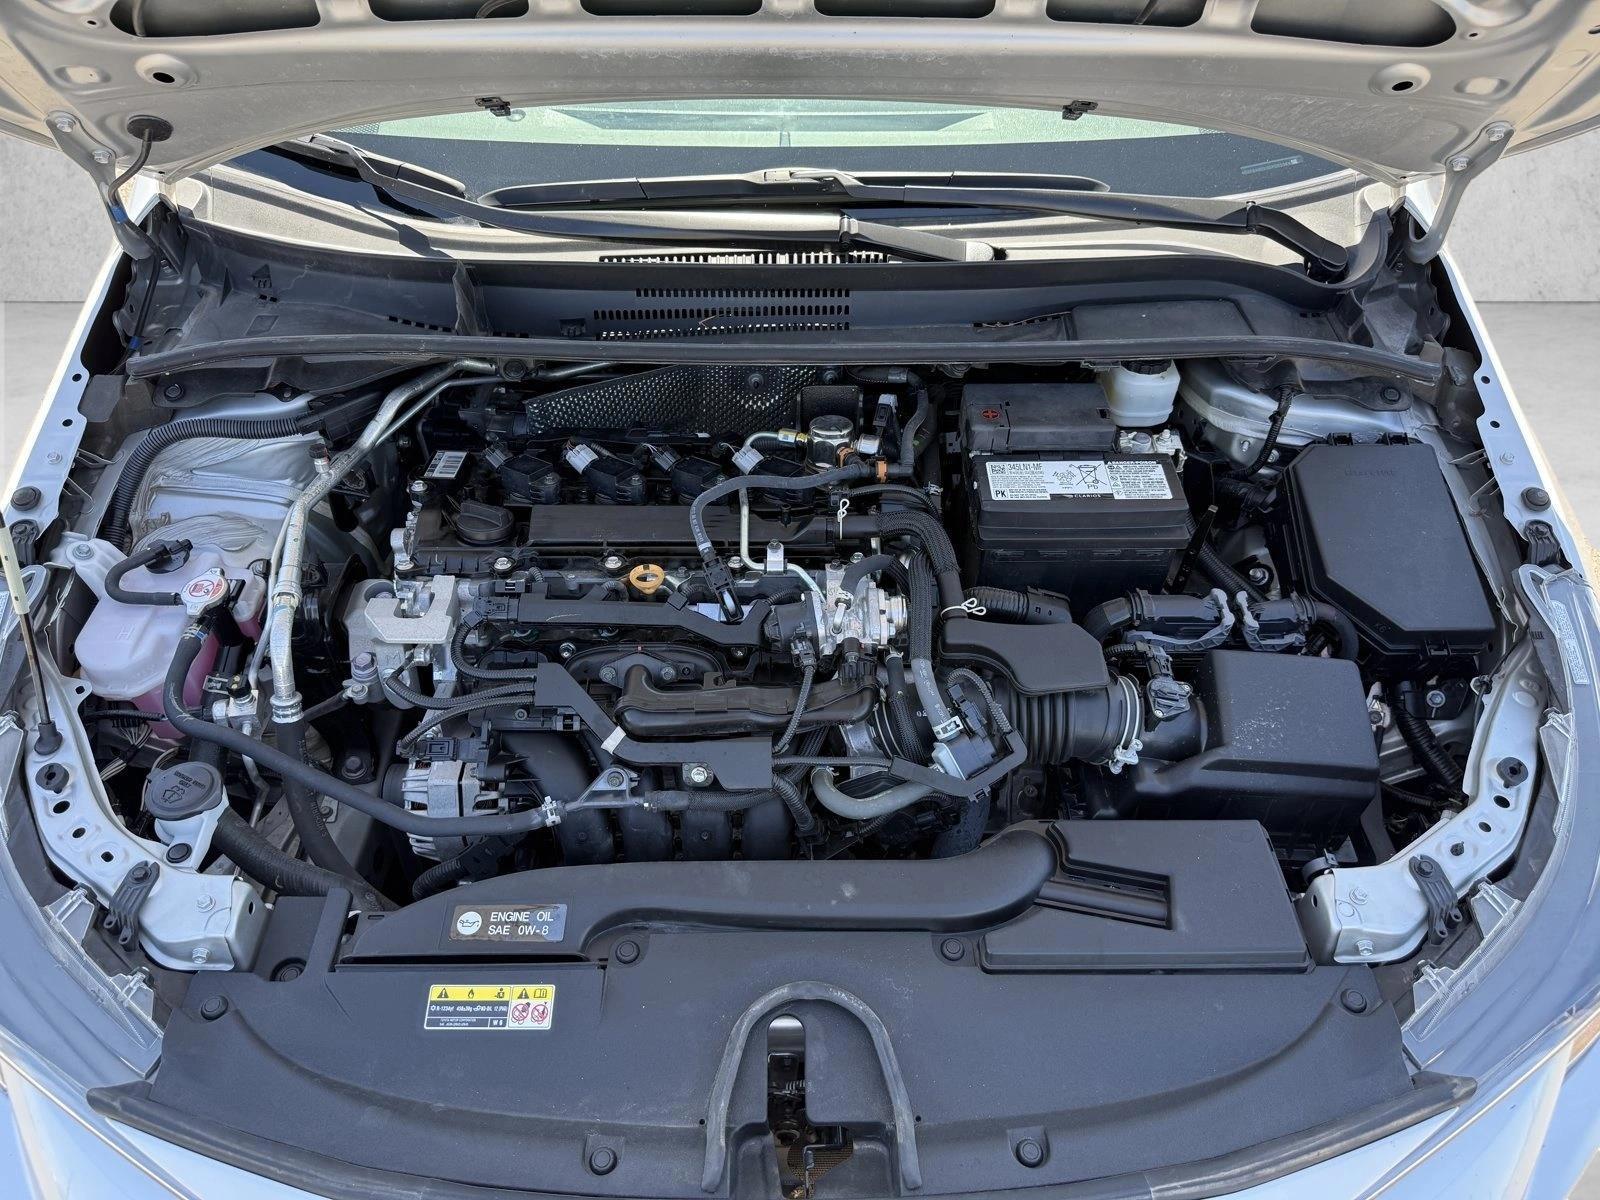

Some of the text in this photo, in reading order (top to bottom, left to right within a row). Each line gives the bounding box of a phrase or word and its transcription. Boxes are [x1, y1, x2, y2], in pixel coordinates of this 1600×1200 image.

[995, 490, 1007, 498] PK
[490, 911, 554, 922] ENGINE OIL
[488, 925, 549, 935] SAE 0W-8
